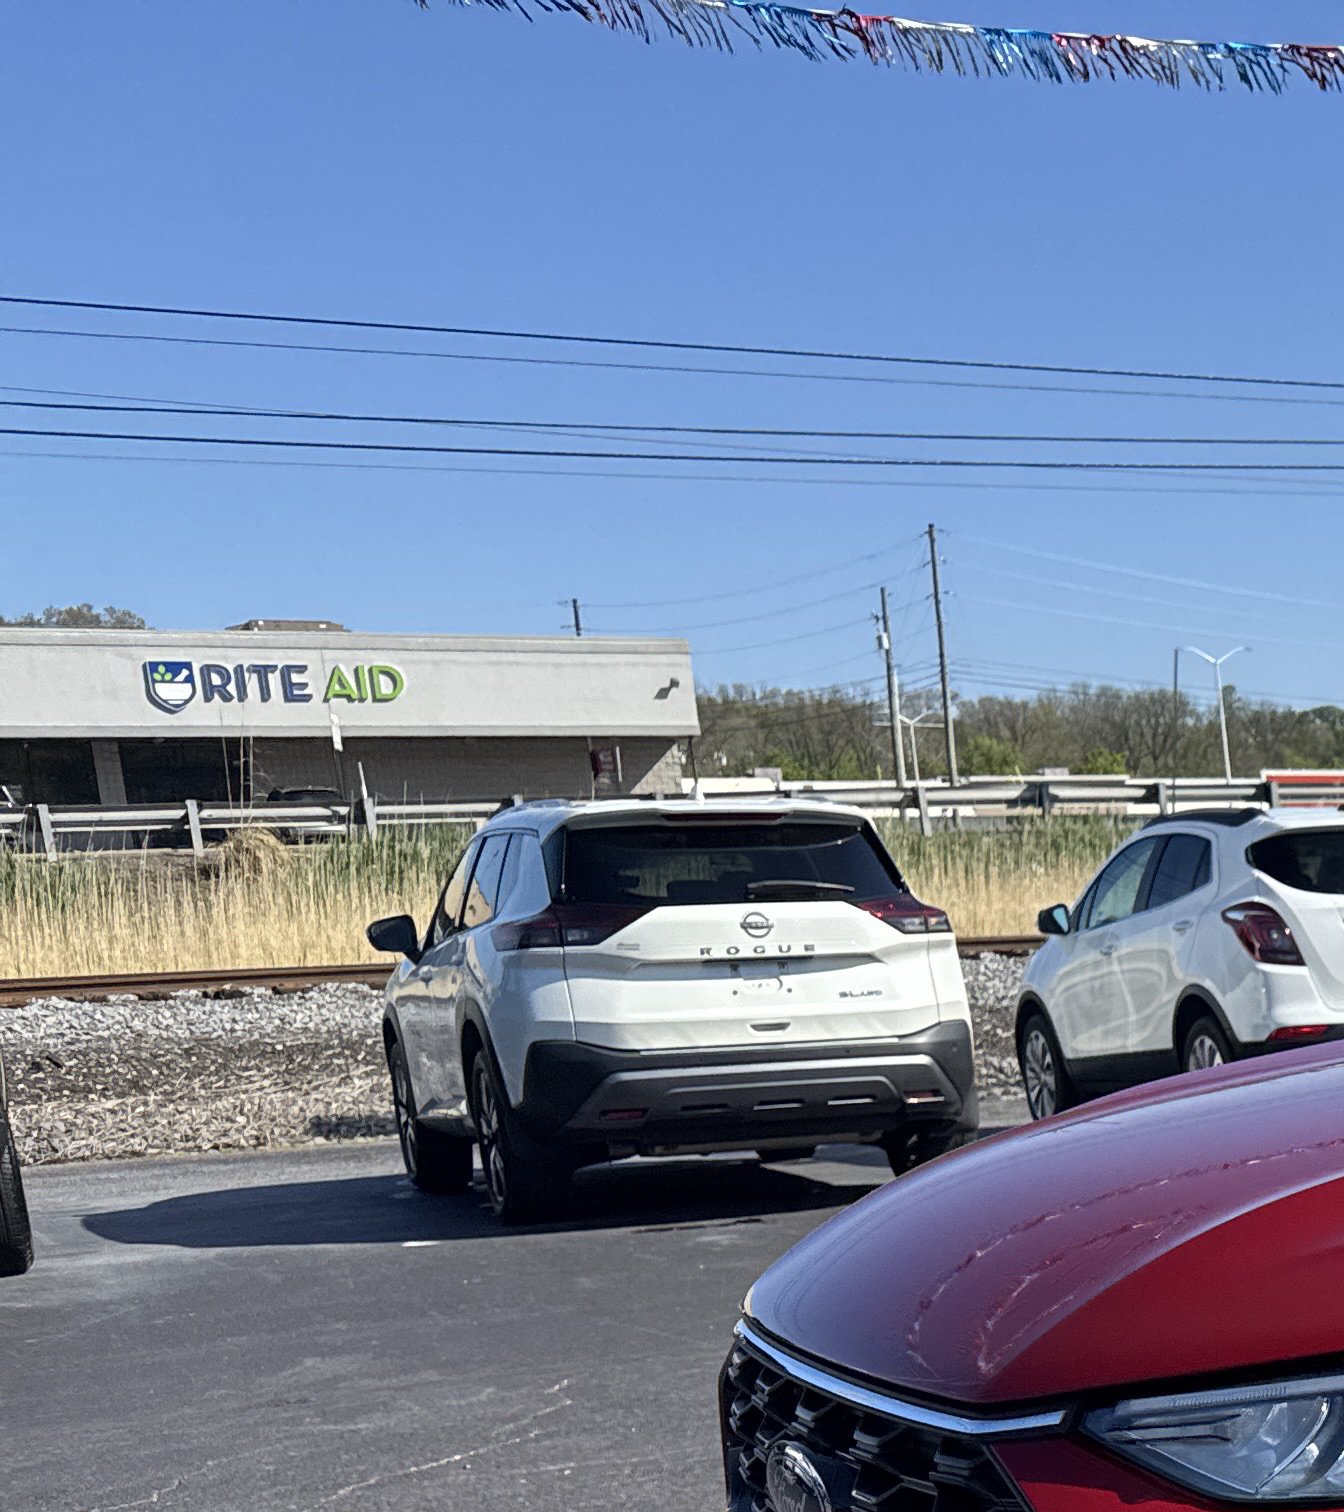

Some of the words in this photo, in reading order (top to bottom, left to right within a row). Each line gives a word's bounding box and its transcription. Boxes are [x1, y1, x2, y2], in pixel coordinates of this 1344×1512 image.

[200, 663, 313, 703] RITE
[322, 664, 405, 703] AID
[700, 944, 816, 957] ROGUE
